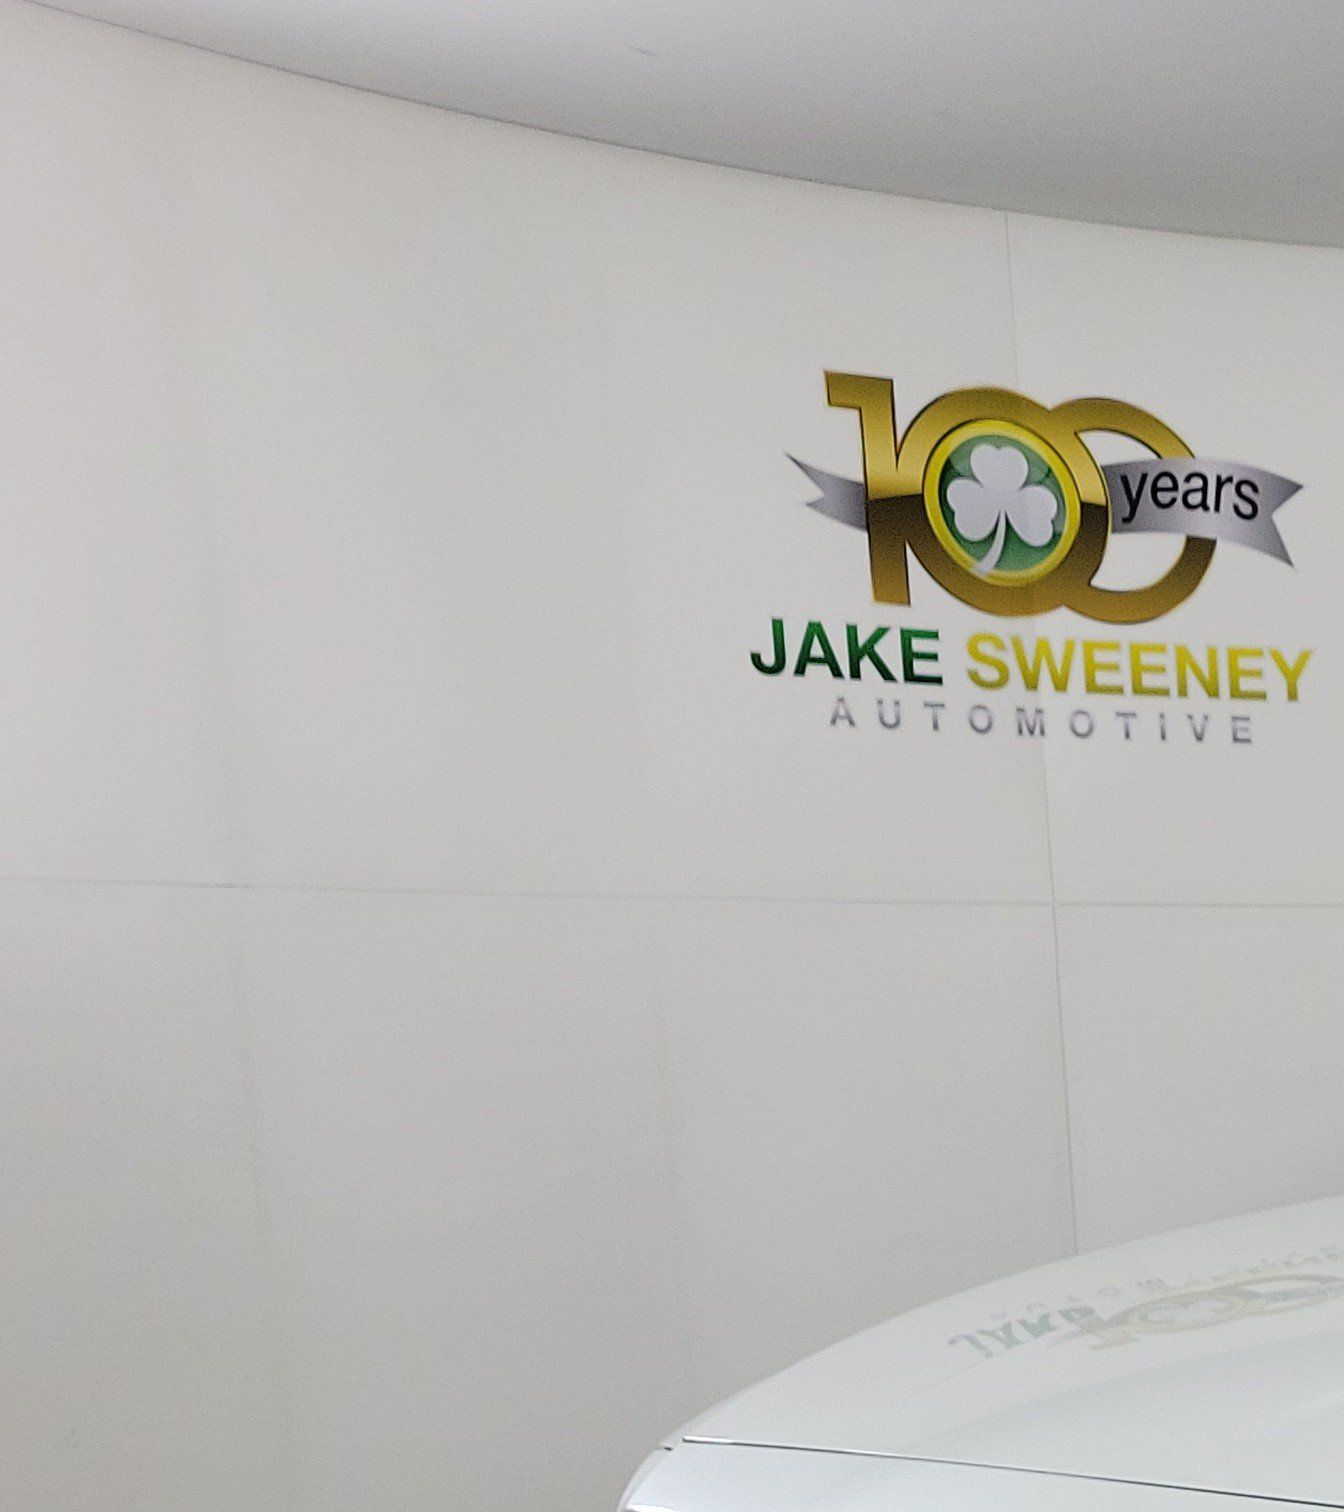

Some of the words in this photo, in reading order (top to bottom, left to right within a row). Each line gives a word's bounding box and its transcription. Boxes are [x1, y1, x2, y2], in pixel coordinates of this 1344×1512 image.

[823, 370, 1217, 626] 100
[1120, 469, 1260, 524] years
[750, 616, 944, 686] JAKE
[966, 632, 1314, 702] SWEENEY
[829, 697, 1254, 745] AUTOMOTIVE
